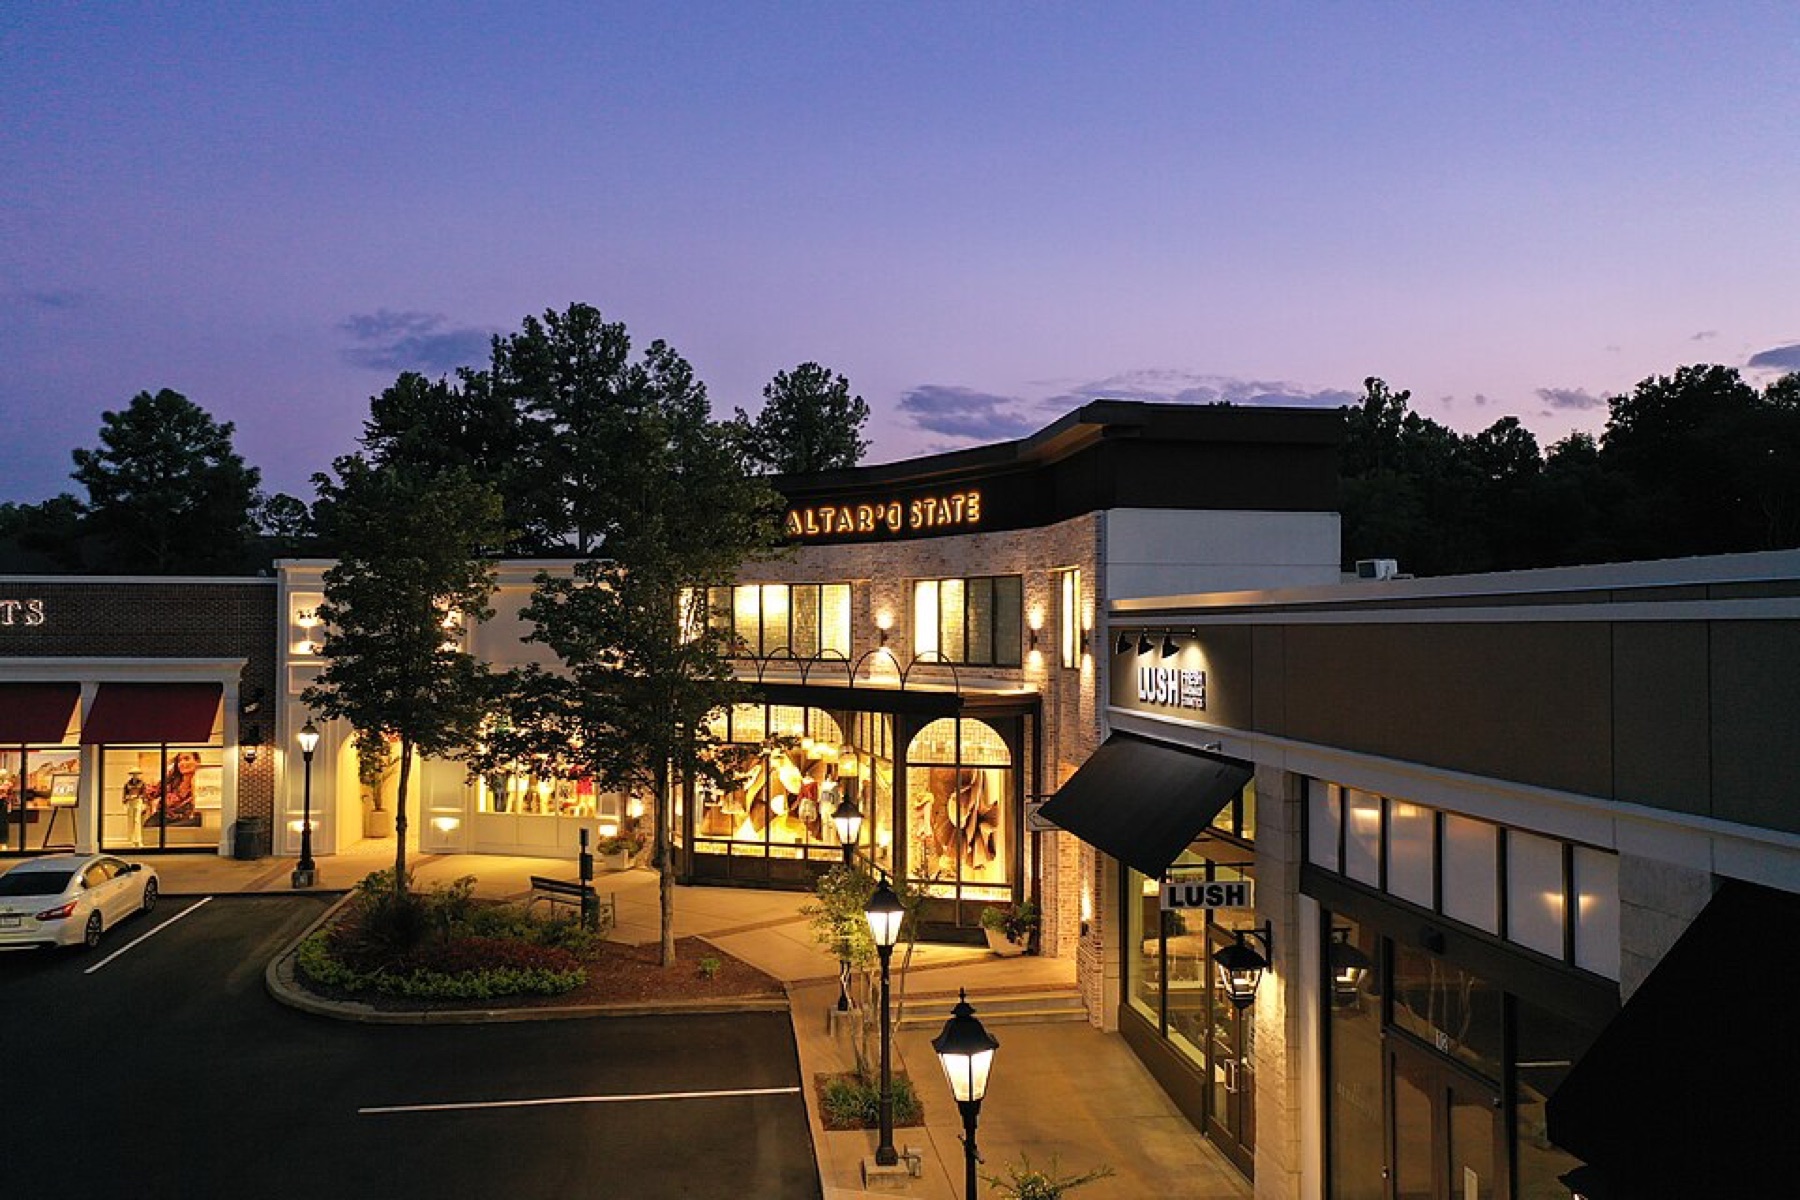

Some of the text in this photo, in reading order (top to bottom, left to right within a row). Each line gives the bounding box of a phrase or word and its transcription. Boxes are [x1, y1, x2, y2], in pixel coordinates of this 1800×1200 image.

[909, 491, 981, 529] STATE
[1138, 667, 1180, 704] LUSH
[1168, 884, 1244, 907] LUSH
